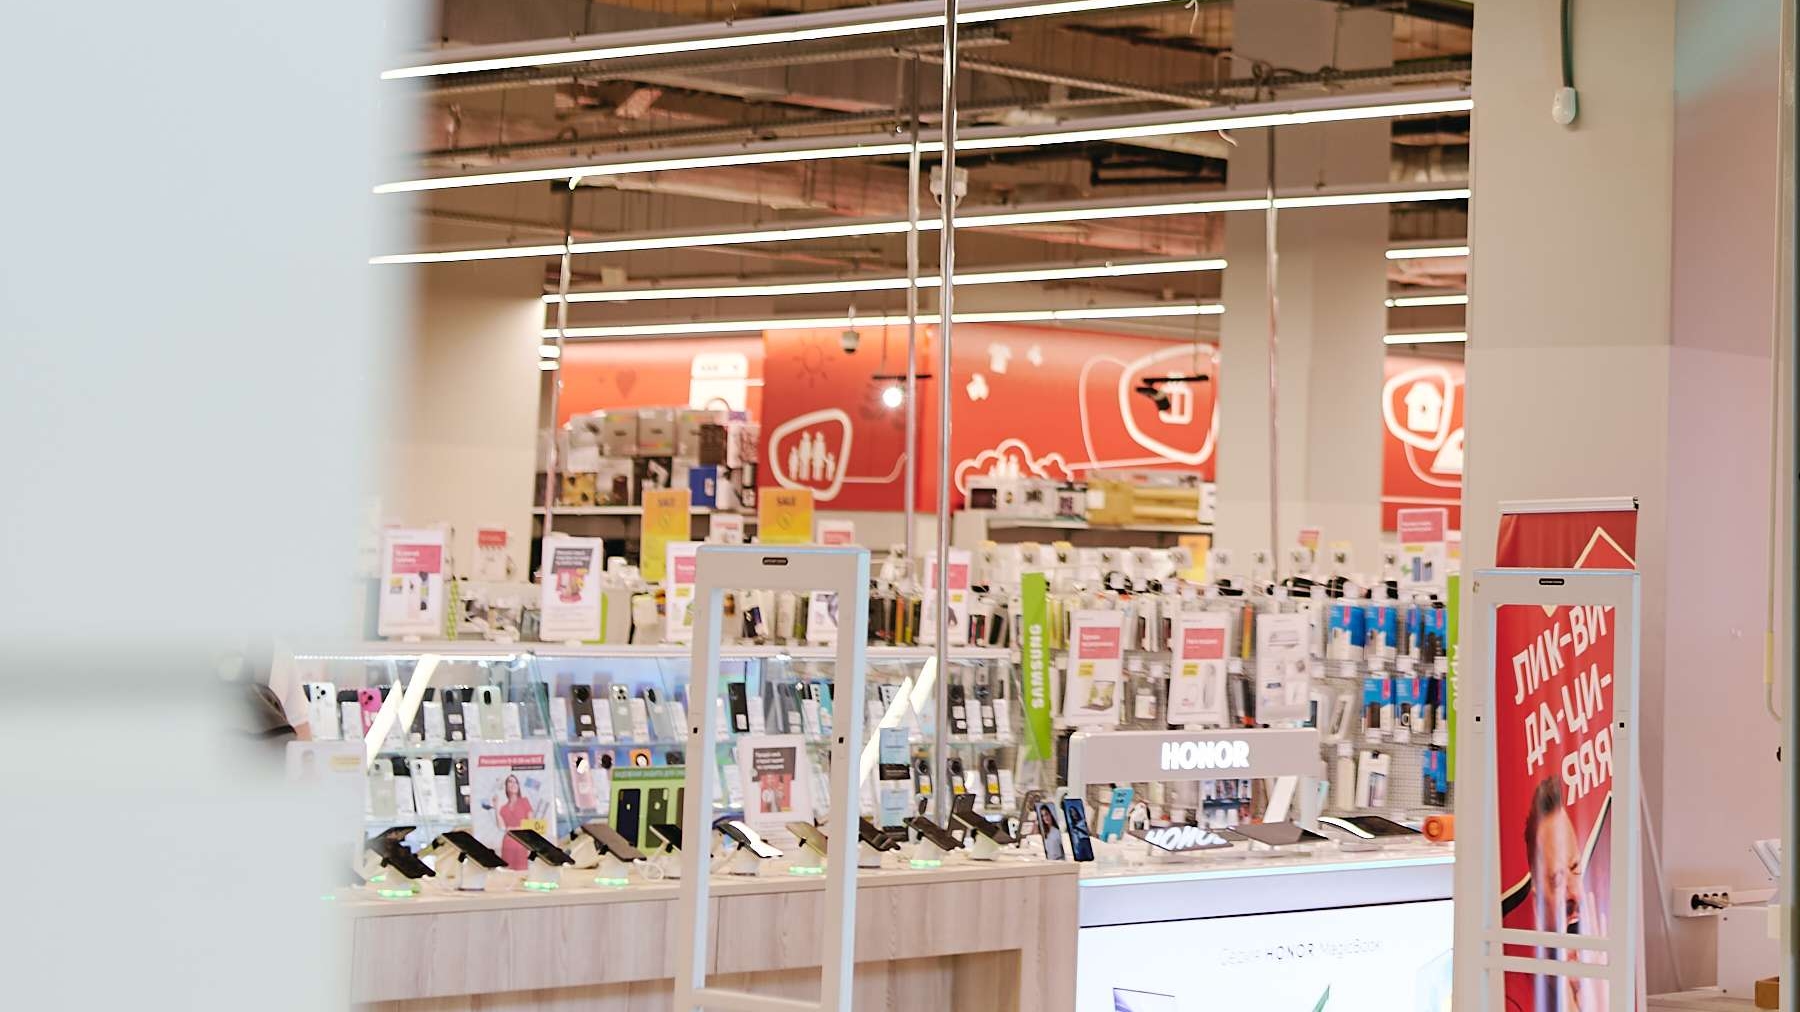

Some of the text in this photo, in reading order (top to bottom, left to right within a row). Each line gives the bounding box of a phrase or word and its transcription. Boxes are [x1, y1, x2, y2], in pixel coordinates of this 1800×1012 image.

[1031, 624, 1045, 709] SAMSUNG
[1161, 740, 1250, 771] HONOR
[1524, 663, 1611, 776] ДА-ЦИ-
[1561, 723, 1613, 806] ЯЯЯ
